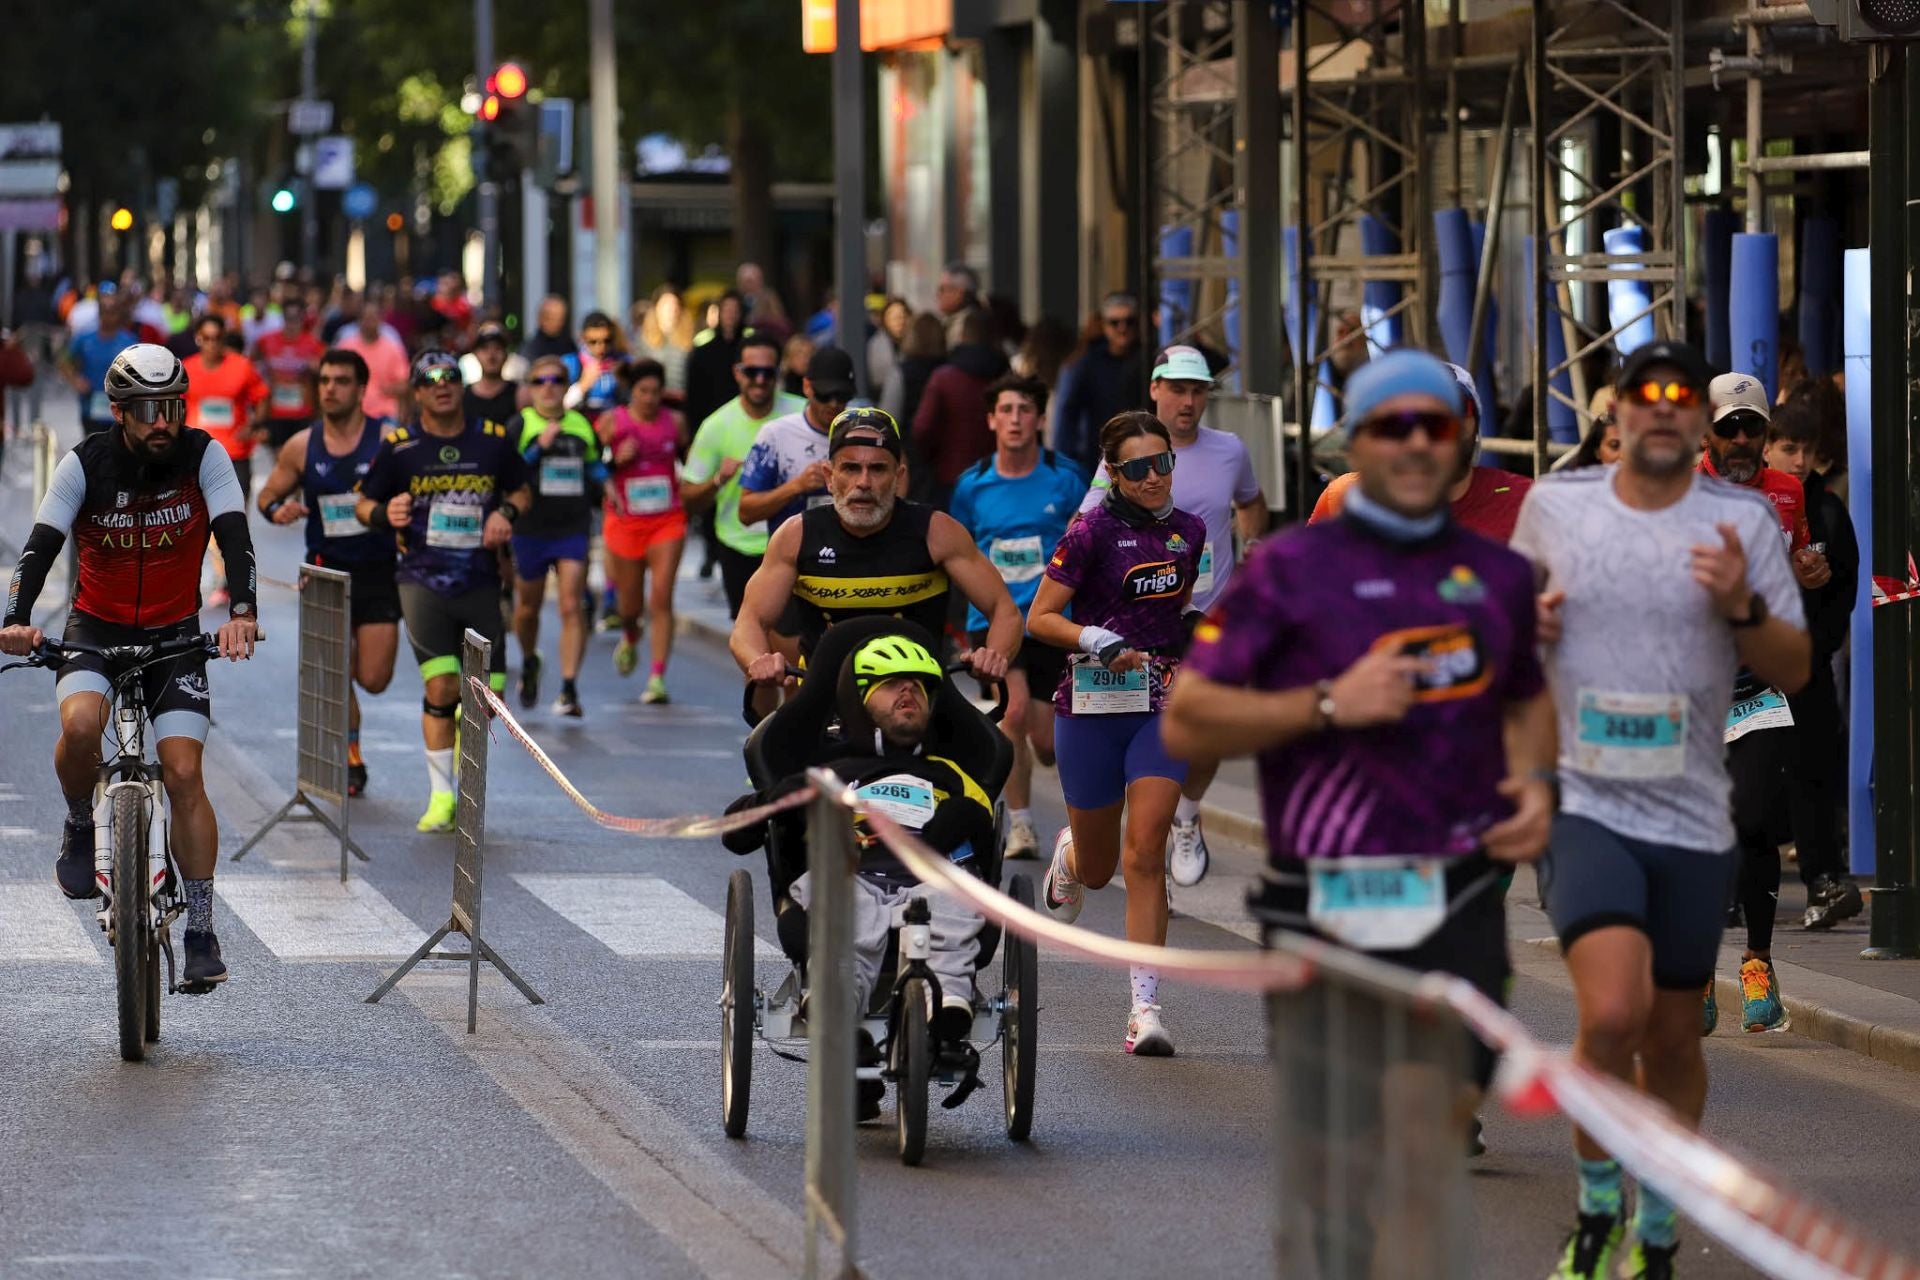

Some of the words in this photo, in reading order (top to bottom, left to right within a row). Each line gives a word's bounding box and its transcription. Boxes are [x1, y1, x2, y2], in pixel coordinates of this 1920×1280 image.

[1157, 565, 1176, 576] más
[800, 579, 846, 599] NCADAS
[850, 586, 890, 598] SOBRE
[1134, 573, 1177, 593] Trigo
[1093, 671, 1126, 686] 2976
[1733, 700, 1764, 718] 4725
[870, 785, 911, 799] 5265
